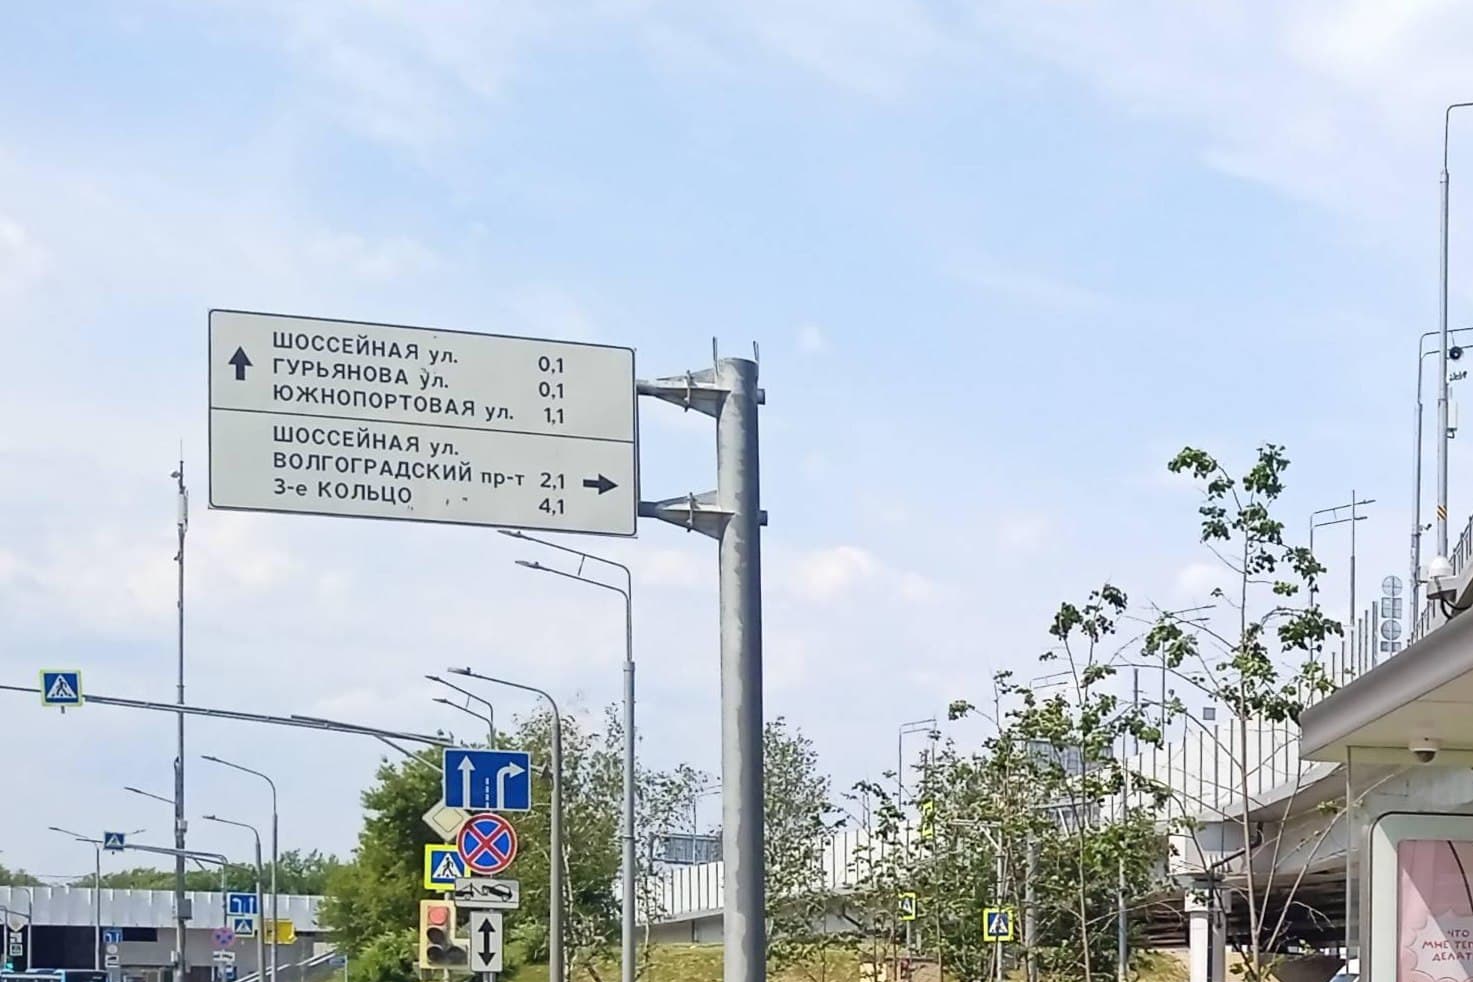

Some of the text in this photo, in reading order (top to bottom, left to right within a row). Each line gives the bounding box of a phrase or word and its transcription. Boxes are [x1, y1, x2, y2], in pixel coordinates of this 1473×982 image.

[273, 331, 565, 375] ШОССЕЙНАЯ ул. 0,1
[273, 358, 564, 400] ГУРЬЯНОВА ул. 0,1
[273, 384, 564, 425] ЮЖНОПОРТОВАЯ ул. 1,1
[273, 426, 459, 457] ШОССЕЙНАЯ ул.
[274, 452, 565, 491] ВОЛГОГРАДСКИЙ пр-т 2,1
[317, 481, 412, 504] КОЛЬЦО
[538, 498, 565, 516] 4,1
[1422, 940, 1449, 949] МНЕ
[1447, 929, 1470, 938] ЧТО
